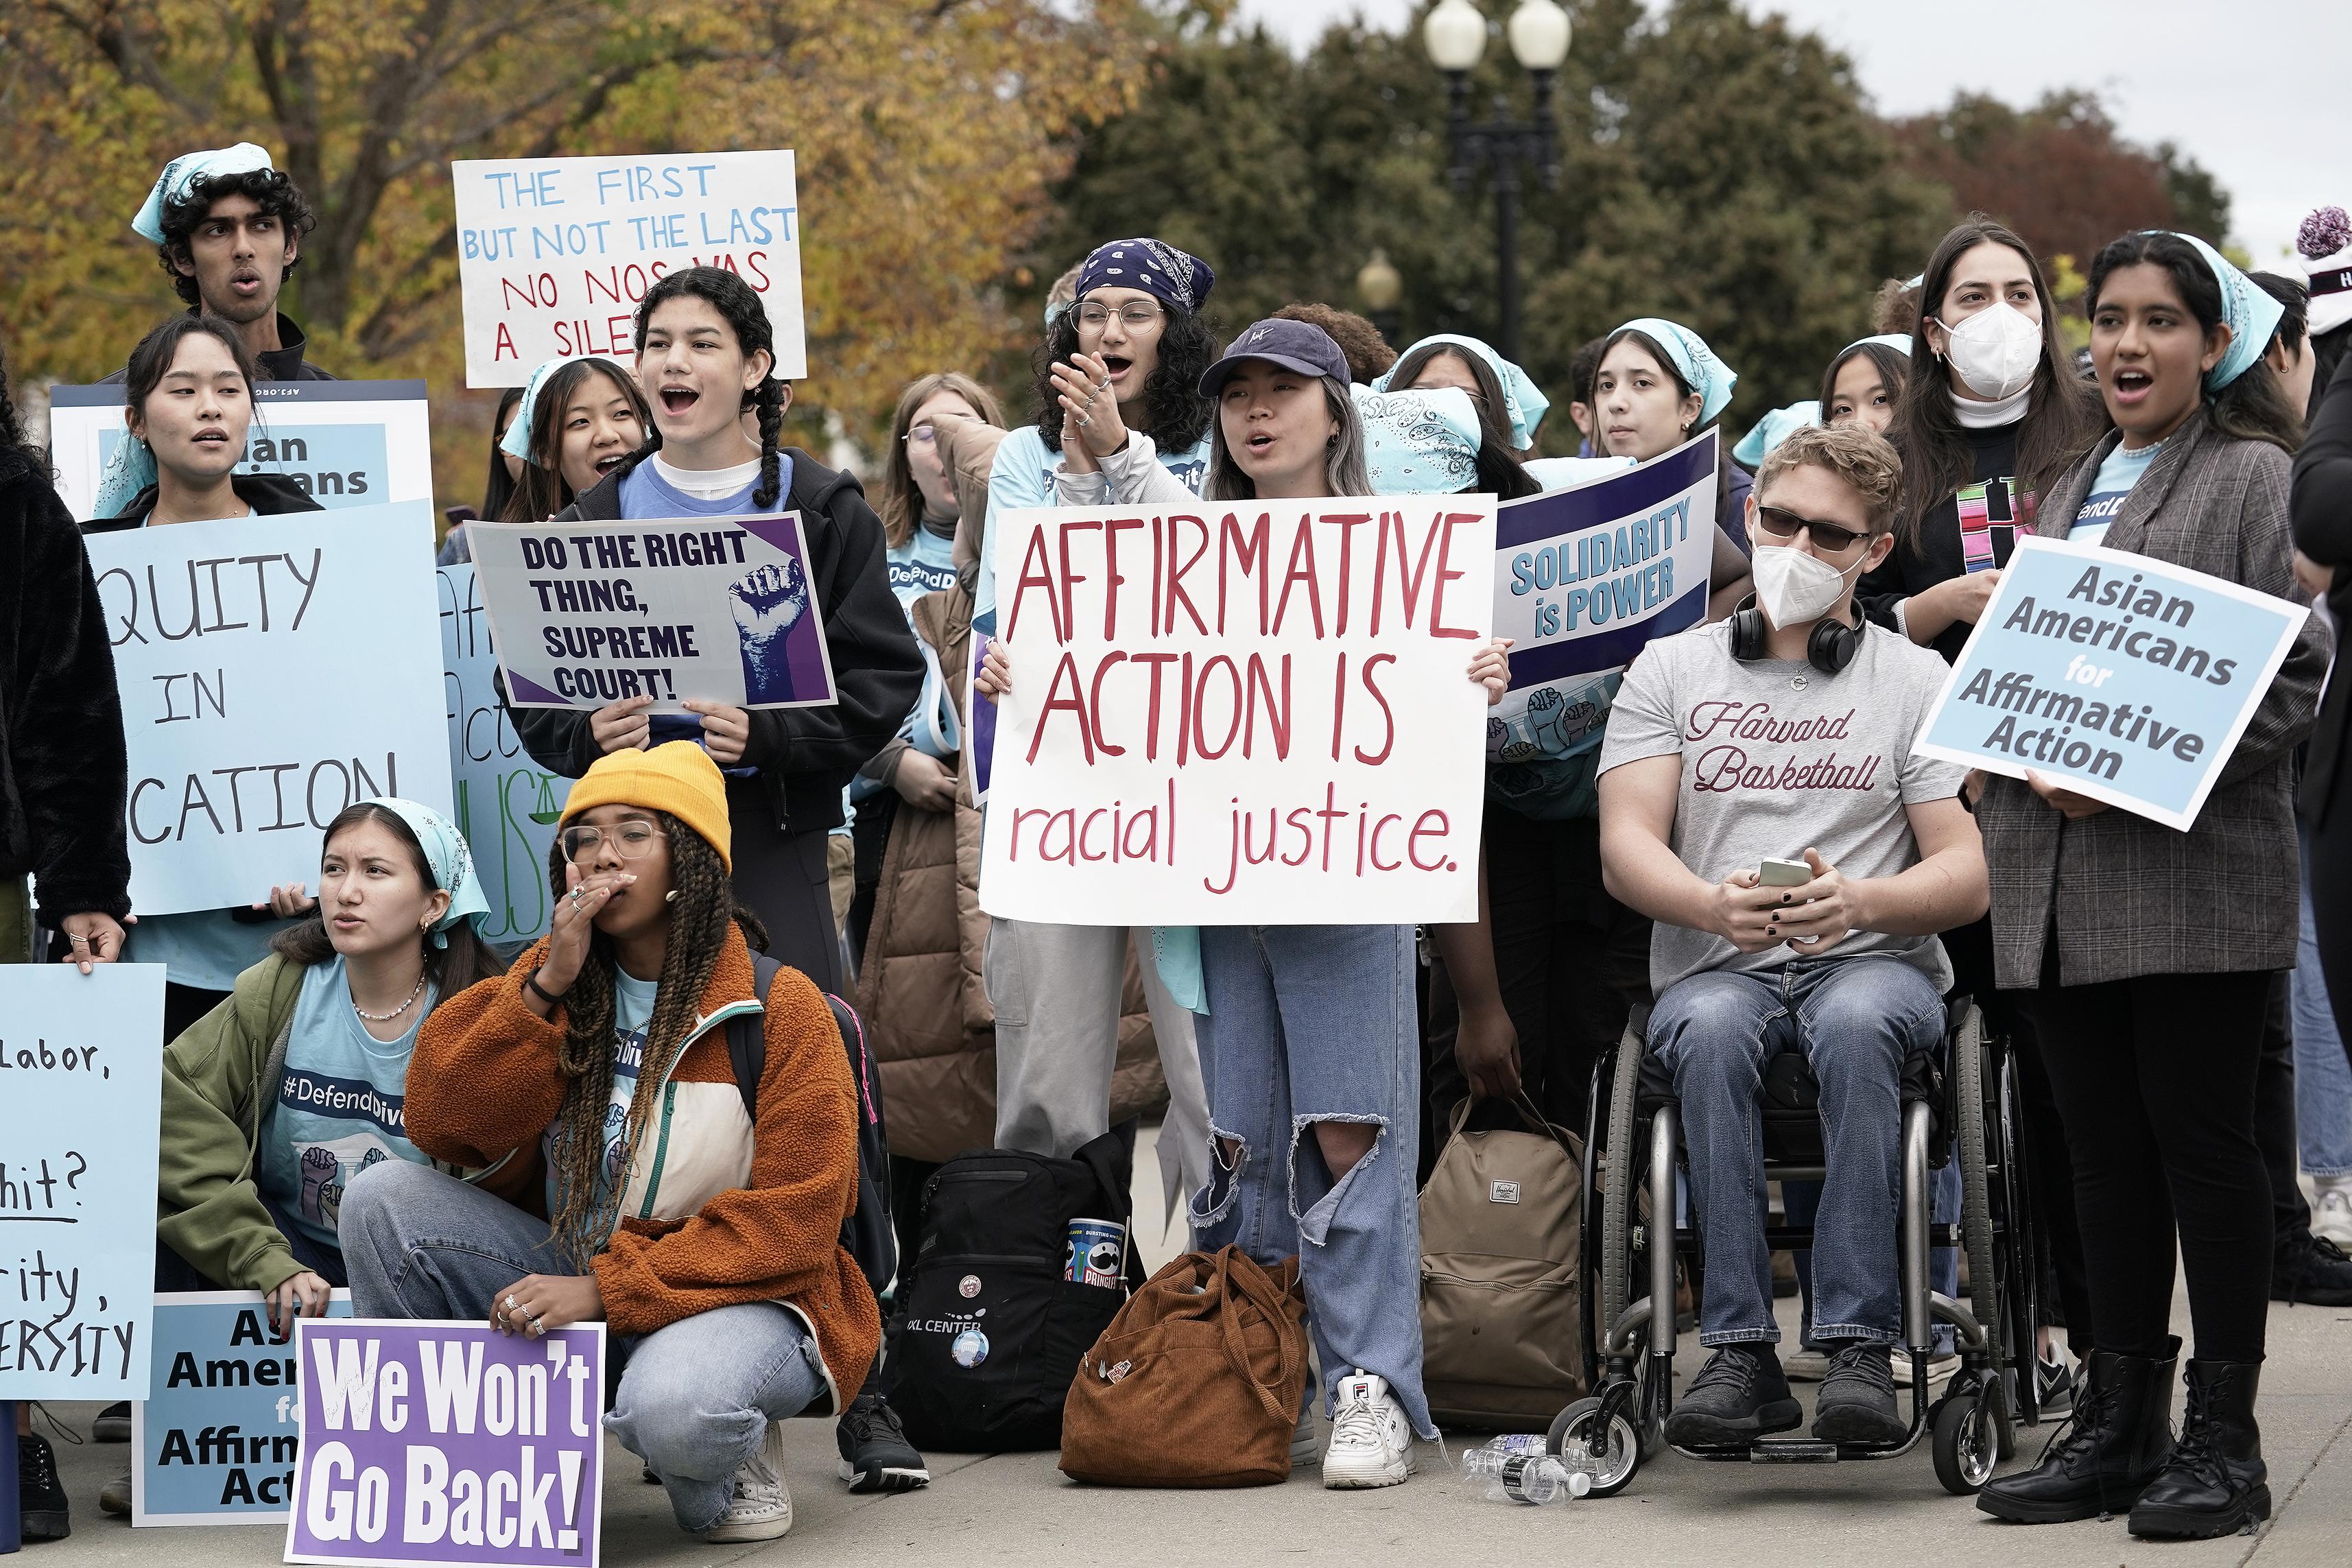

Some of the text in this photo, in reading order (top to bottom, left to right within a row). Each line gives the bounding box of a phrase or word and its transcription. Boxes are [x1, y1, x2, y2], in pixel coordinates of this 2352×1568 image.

[484, 165, 715, 209] THE FIRST
[463, 206, 796, 261] BUT NOT THE LAST
[502, 272, 558, 310] NO
[495, 313, 638, 361] A SILE
[519, 530, 748, 571] DO THE RIGHT
[1510, 495, 1691, 596] SOLIDARITY
[528, 578, 649, 618] THING,
[1006, 510, 1485, 647] AFFIRMATIVE
[1534, 556, 1674, 639] is POWER
[2066, 565, 2195, 629] Asian
[542, 624, 700, 659] SUPREME
[2002, 596, 2238, 687] Americans
[152, 668, 226, 724] IN
[554, 666, 677, 700] COURT!
[2063, 654, 2114, 689] for
[1025, 649, 1291, 770] ACTION
[1331, 651, 1397, 766] IS
[1685, 701, 1855, 744] Harvard
[1958, 667, 2205, 763] Affirmative
[1694, 745, 1881, 793] Basketball
[1982, 715, 2124, 781] Action
[1009, 776, 1458, 894] racial justice.
[0, 1038, 110, 1080] Labor,
[284, 1076, 407, 1128] #DefendDiv
[0, 1150, 87, 1207] hit?
[1086, 1230, 1109, 1238] BURSTING
[310, 1338, 409, 1434] We
[418, 1340, 590, 1438] Won't
[305, 1440, 584, 1551] Go Back!
